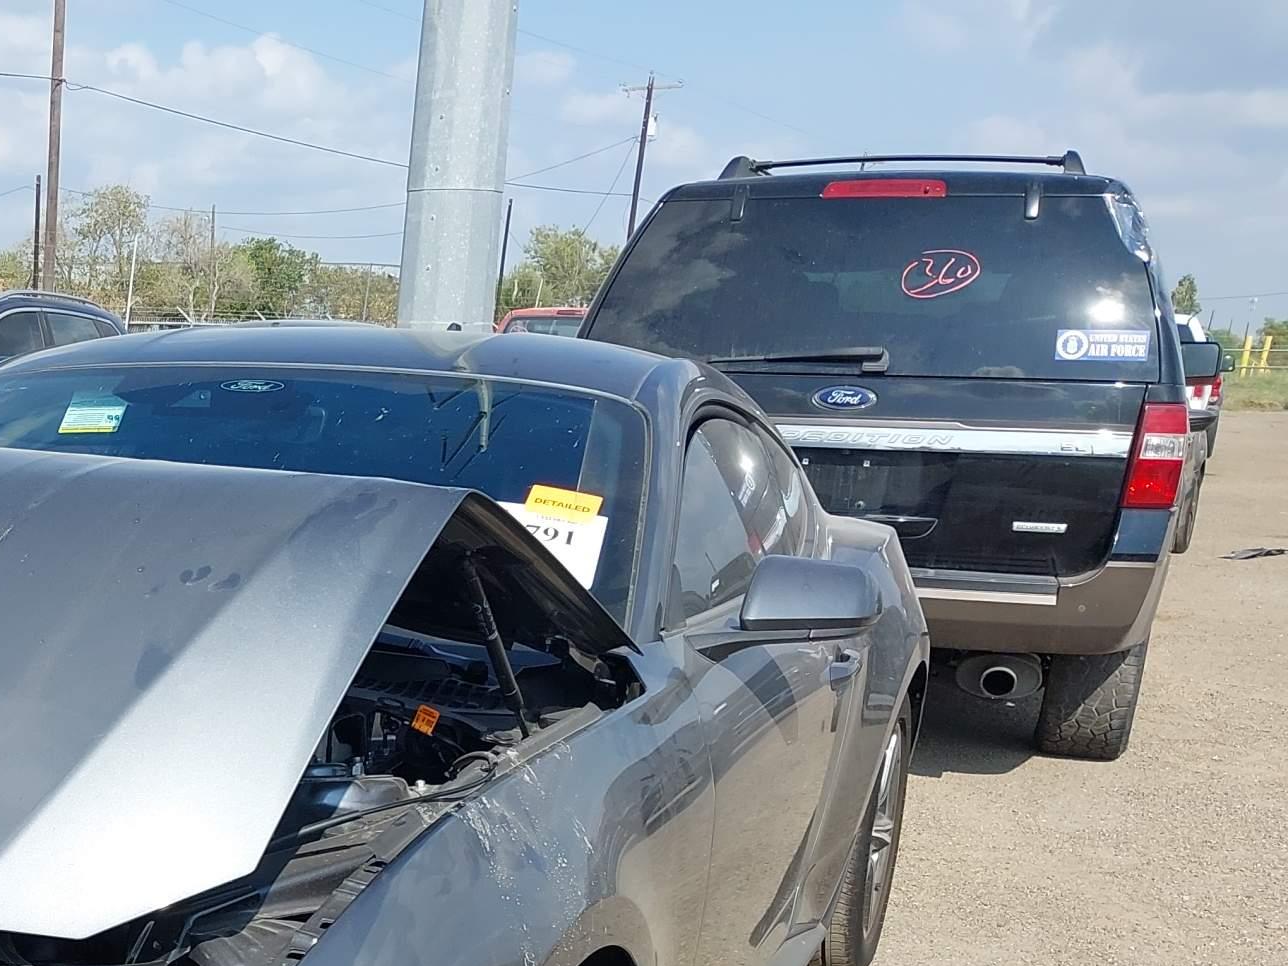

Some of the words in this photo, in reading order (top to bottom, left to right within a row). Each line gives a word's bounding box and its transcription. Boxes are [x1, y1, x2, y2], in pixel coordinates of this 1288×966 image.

[1088, 343, 1108, 356] AIR
[1110, 344, 1146, 357] FORCE
[230, 380, 274, 391] Ford
[827, 390, 862, 405] Ford
[534, 497, 591, 513] DETAILED
